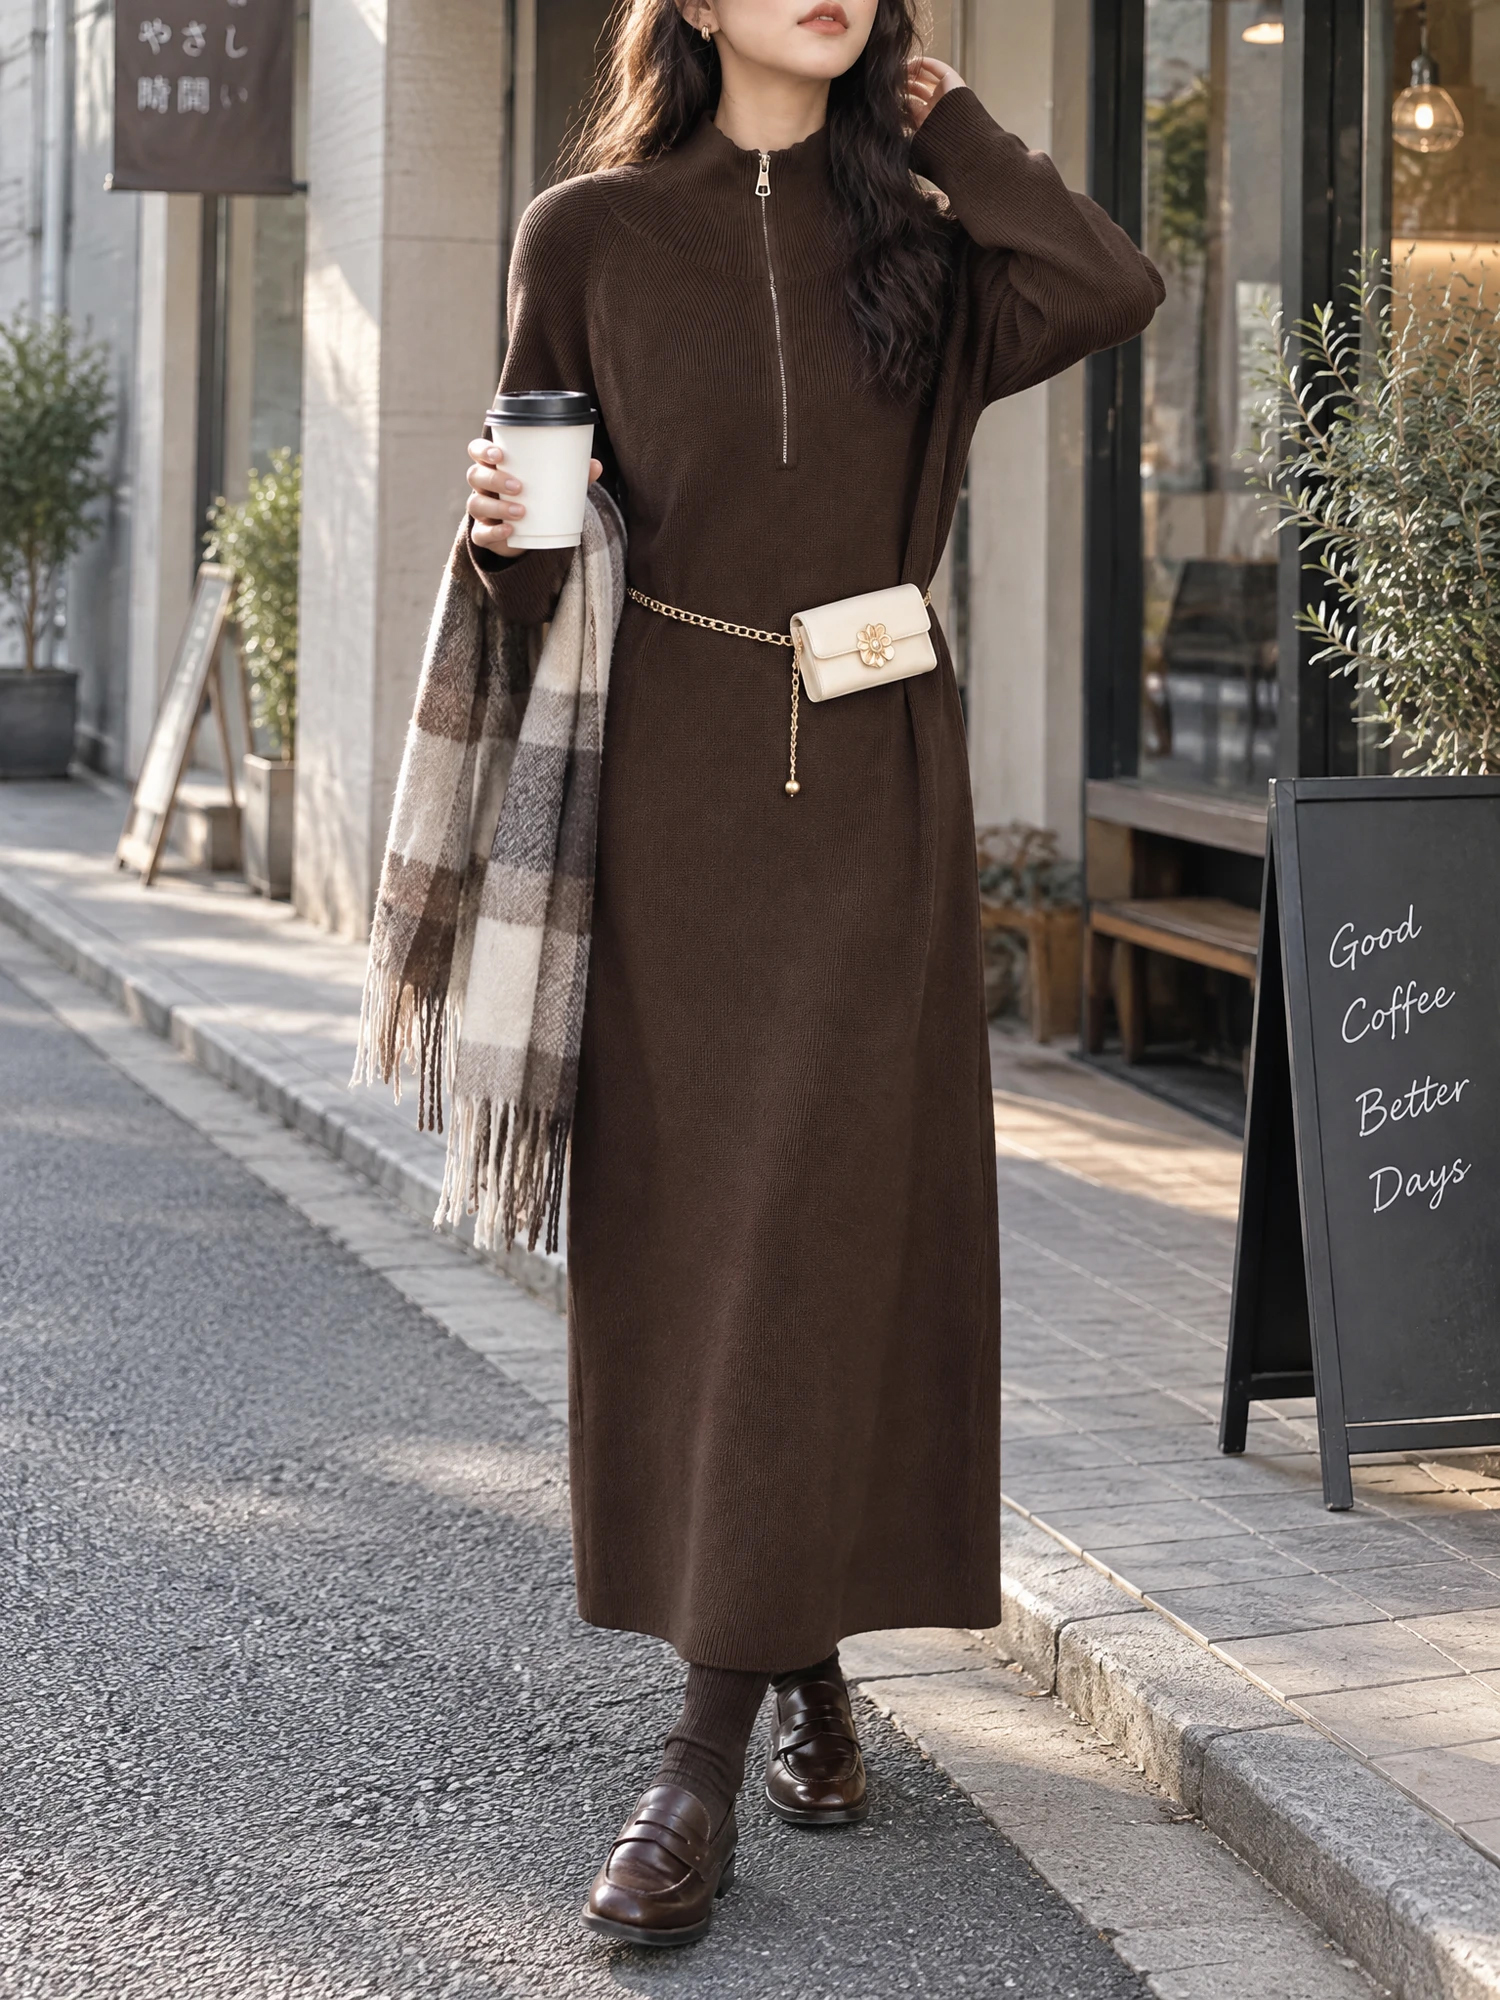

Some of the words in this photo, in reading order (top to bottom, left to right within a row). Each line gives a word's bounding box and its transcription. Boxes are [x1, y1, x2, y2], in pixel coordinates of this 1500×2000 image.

[1329, 904, 1422, 971] Good
[1341, 980, 1456, 1044] Coffee
[1355, 1075, 1470, 1138] Better
[1368, 1158, 1472, 1214] Days
